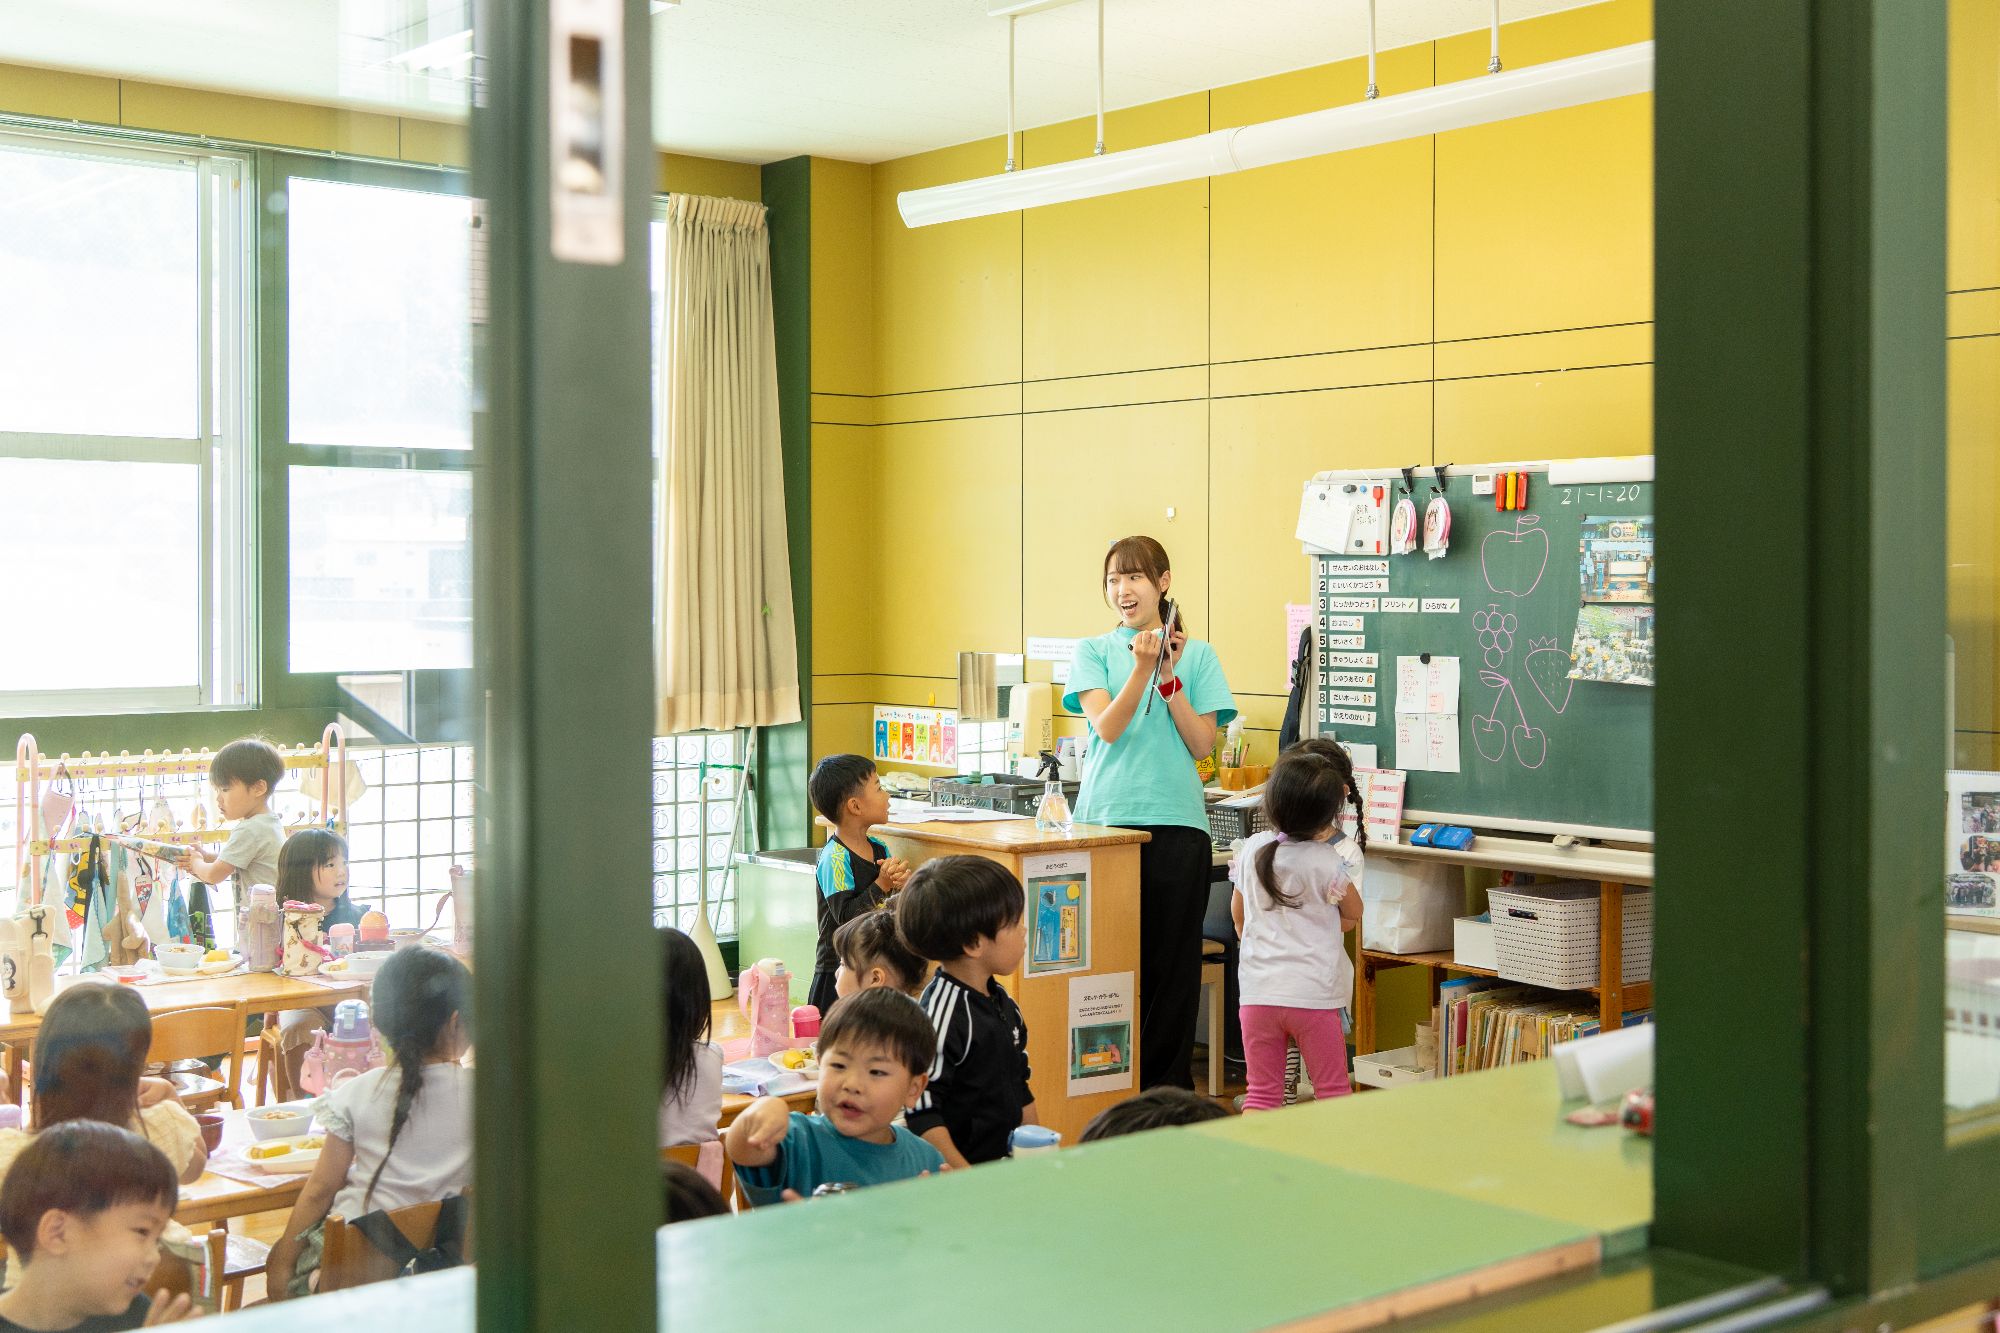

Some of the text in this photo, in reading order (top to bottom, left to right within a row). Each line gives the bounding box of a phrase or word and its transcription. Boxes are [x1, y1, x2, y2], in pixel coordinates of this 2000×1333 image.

[1321, 563, 1380, 573] 1 せんせいのおはなし
[1320, 581, 1326, 590] 2
[1320, 599, 1326, 609] 3
[1425, 602, 1448, 610] ひらがな
[1320, 617, 1354, 627] 4 おはなし
[1320, 636, 1326, 645] 5
[1320, 654, 1364, 664] 6 きゅうしょく
[1320, 674, 1326, 683] 7
[1320, 693, 1326, 702] 8
[1320, 710, 1365, 721] 9 かえりのかい
